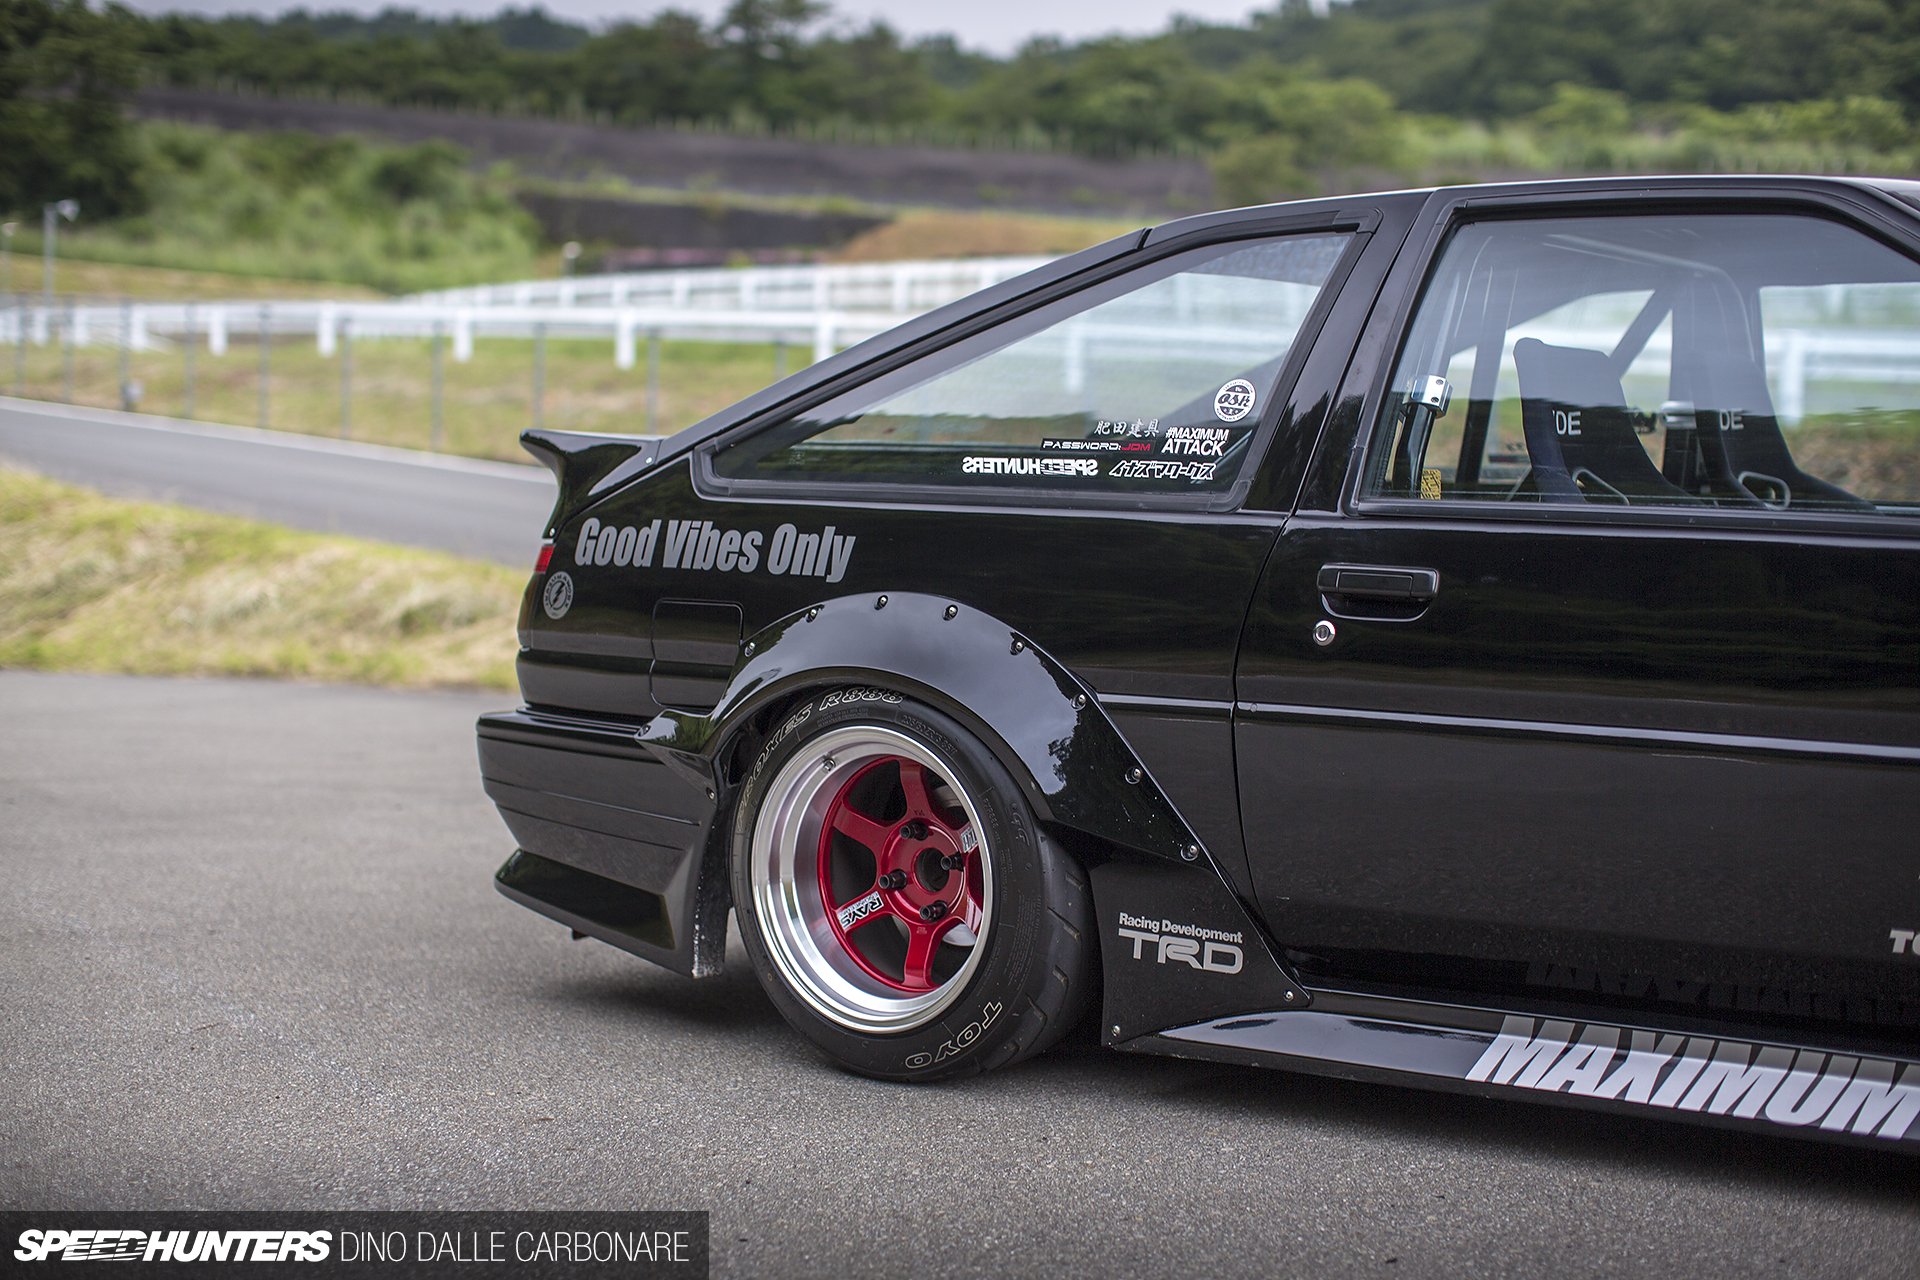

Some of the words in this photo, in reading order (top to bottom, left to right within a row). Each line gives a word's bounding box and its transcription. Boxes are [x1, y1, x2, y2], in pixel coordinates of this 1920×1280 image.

[1094, 419, 1159, 438] 肥田建具
[1165, 427, 1229, 441] #MAXIMUM
[1161, 439, 1226, 456] ATTACK
[574, 517, 661, 567] Good
[662, 519, 763, 573] Vibes
[767, 523, 856, 583] Only
[839, 897, 884, 928] RAYS
[1119, 912, 1160, 933] Racing
[1162, 919, 1243, 943] Development
[1118, 928, 1244, 975] TRD
[905, 1001, 1003, 1069] TOYO
[1465, 1014, 1920, 1139] MAXIMUM
